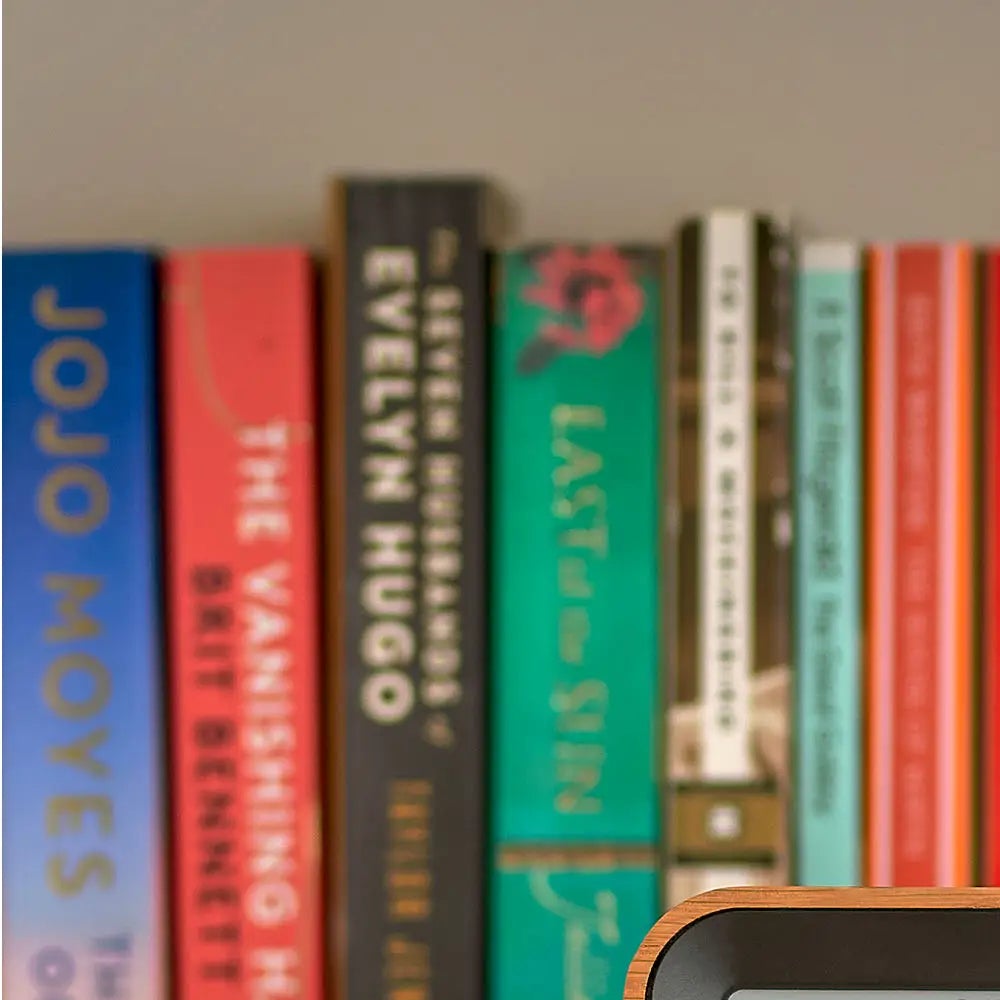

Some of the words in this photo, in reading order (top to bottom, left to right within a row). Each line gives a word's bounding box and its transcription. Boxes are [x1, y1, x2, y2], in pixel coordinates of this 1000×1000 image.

[31, 287, 108, 535] JOJO
[239, 422, 290, 542] THE
[362, 248, 417, 502] EVELYN
[421, 286, 461, 439] SEVEN
[190, 566, 239, 694] BRIT
[362, 525, 417, 726] HUGO
[421, 455, 461, 709] HUSBANDS
[42, 573, 115, 898] MOYES
[194, 718, 242, 987] BENNETT
[243, 566, 294, 922] VANISHING
[549, 680, 611, 816] SUN
